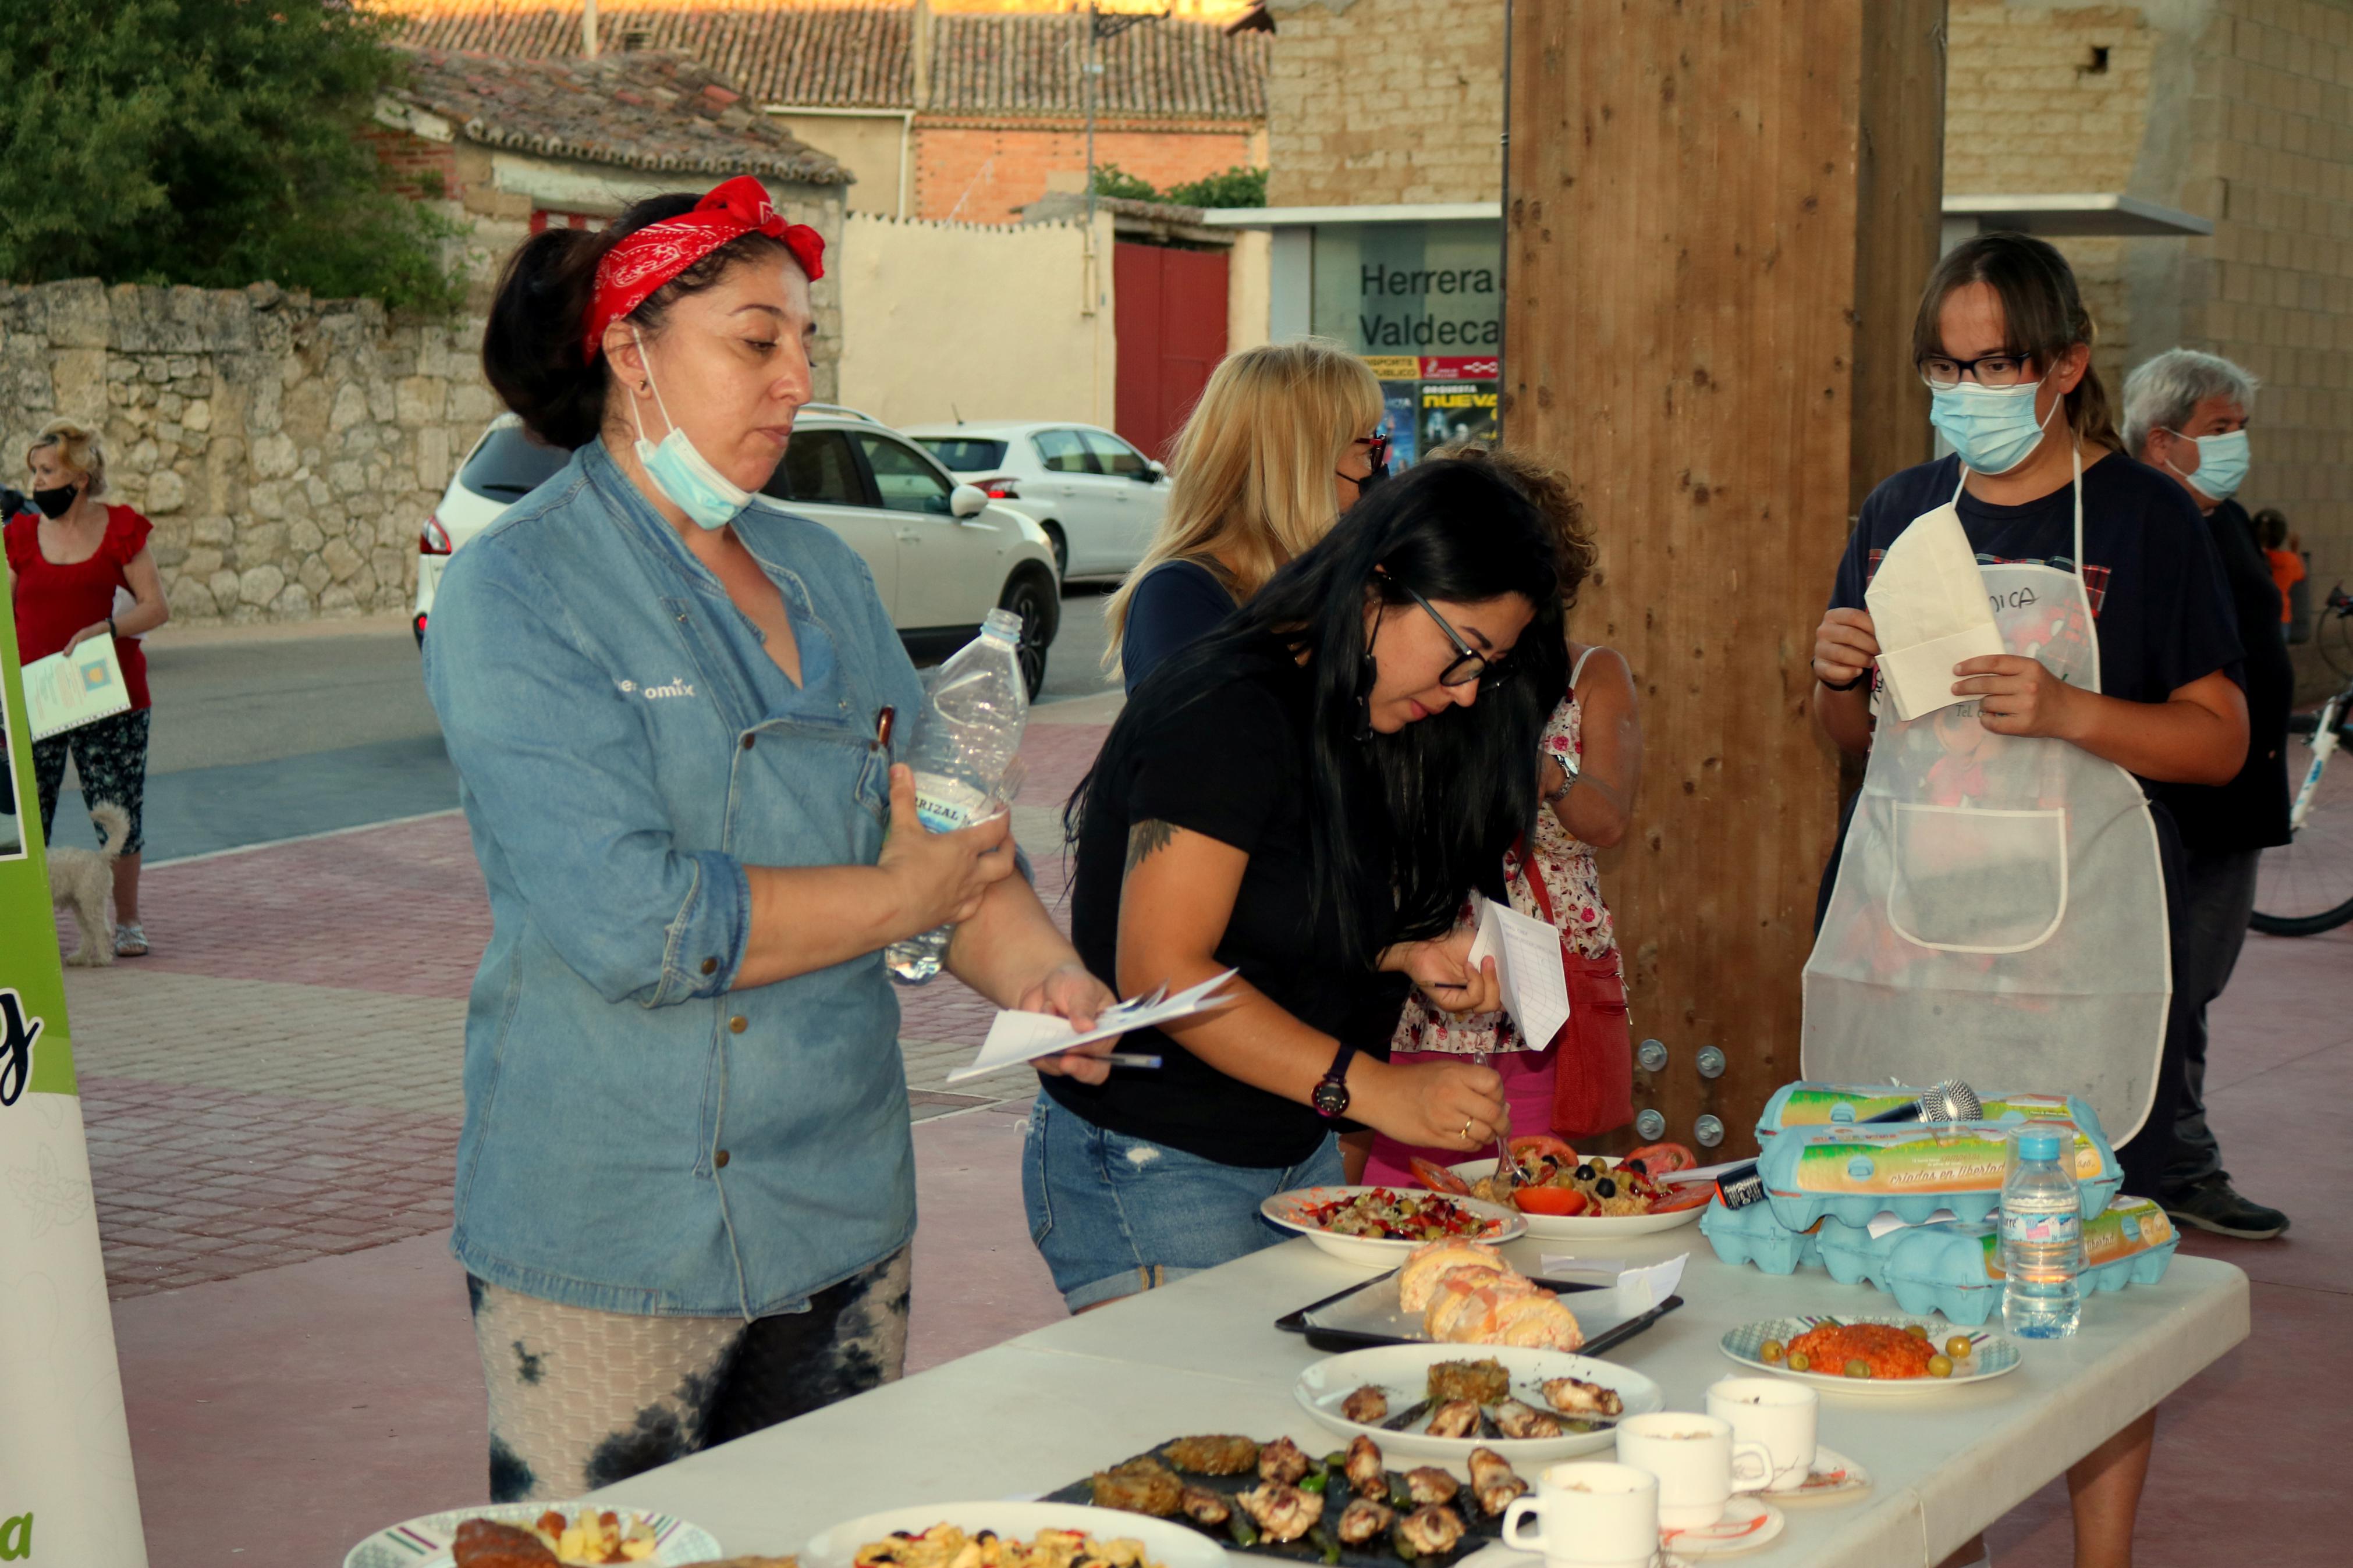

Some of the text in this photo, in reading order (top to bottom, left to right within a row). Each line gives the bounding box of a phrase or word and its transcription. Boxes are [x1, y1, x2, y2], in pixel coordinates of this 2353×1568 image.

[1361, 264, 1493, 296] Herrera
[1360, 314, 1499, 346] Valdeca
[1890, 1169, 1936, 1184] criadas
[1958, 1162, 2006, 1177] libertad
